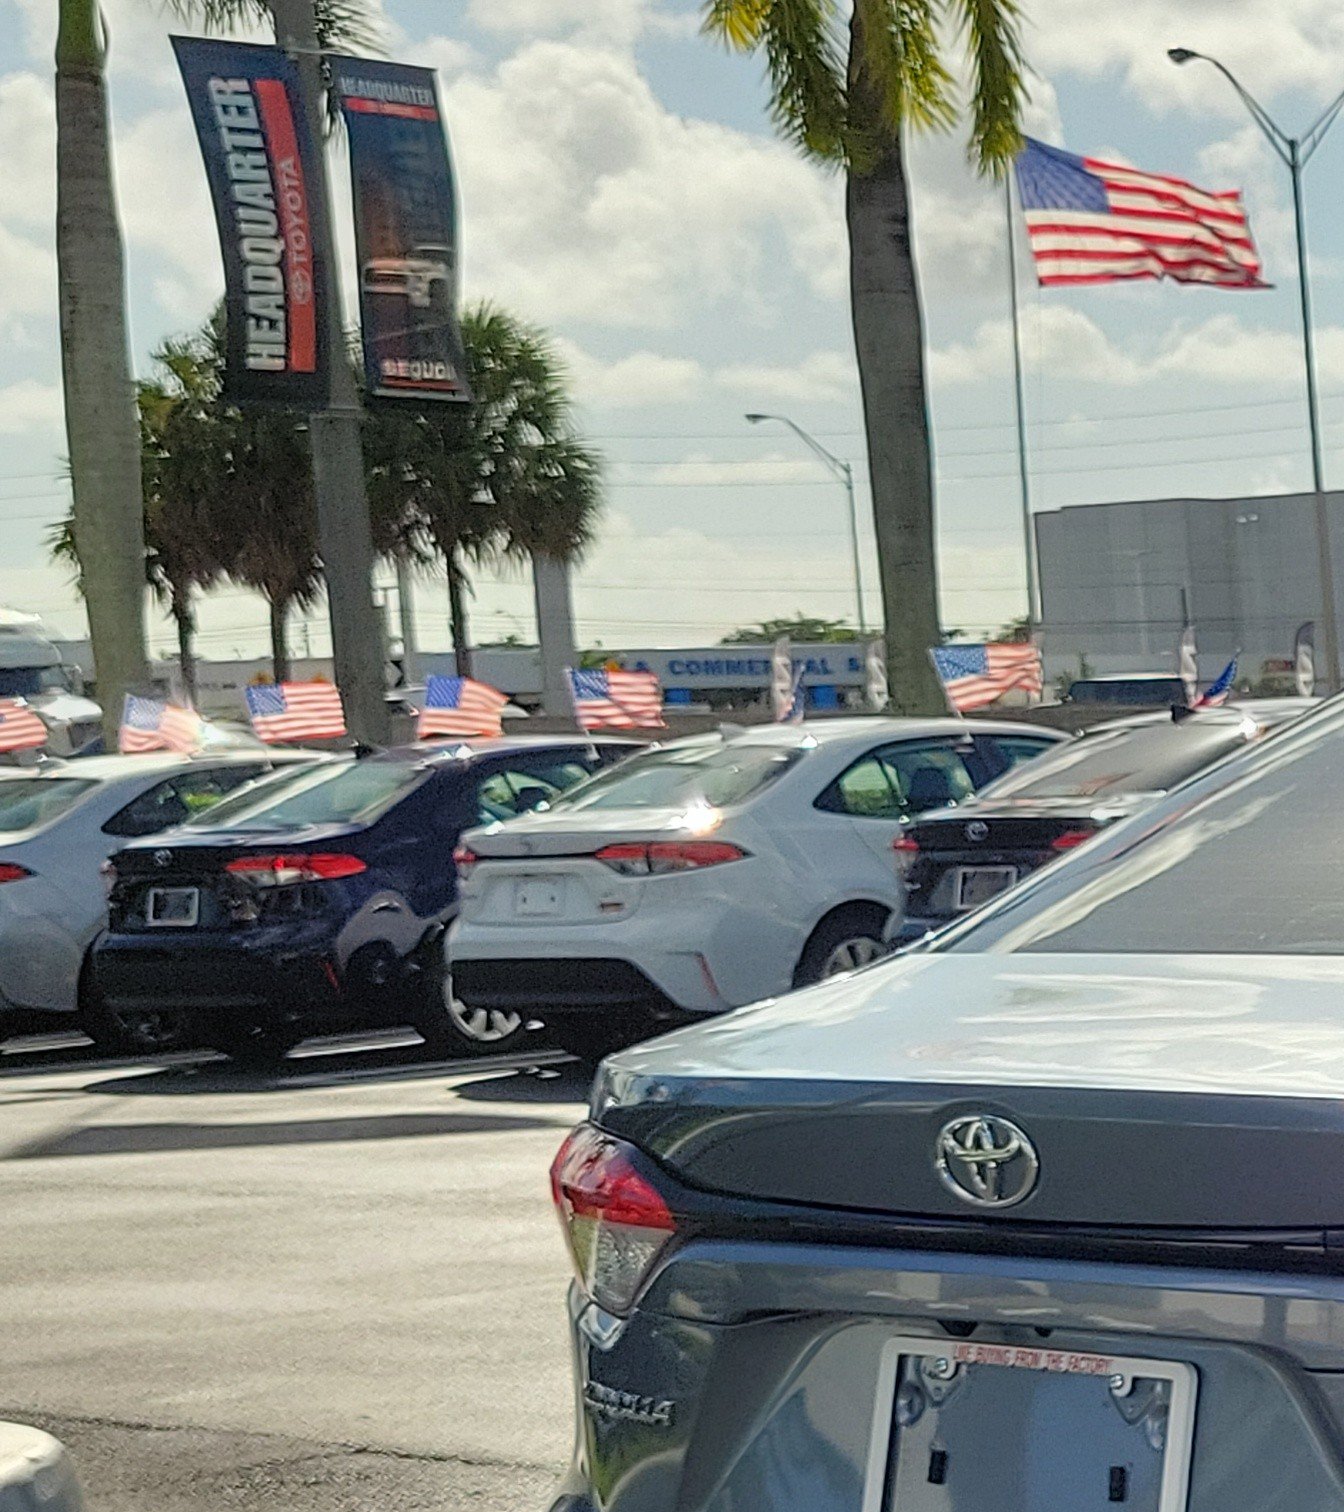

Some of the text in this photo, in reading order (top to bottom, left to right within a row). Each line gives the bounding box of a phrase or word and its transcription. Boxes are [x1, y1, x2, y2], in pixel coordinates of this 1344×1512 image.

[207, 77, 287, 371] HEADQUARTER
[279, 155, 308, 263] TOYOTA
[1067, 1355, 1114, 1375] FACTORY
